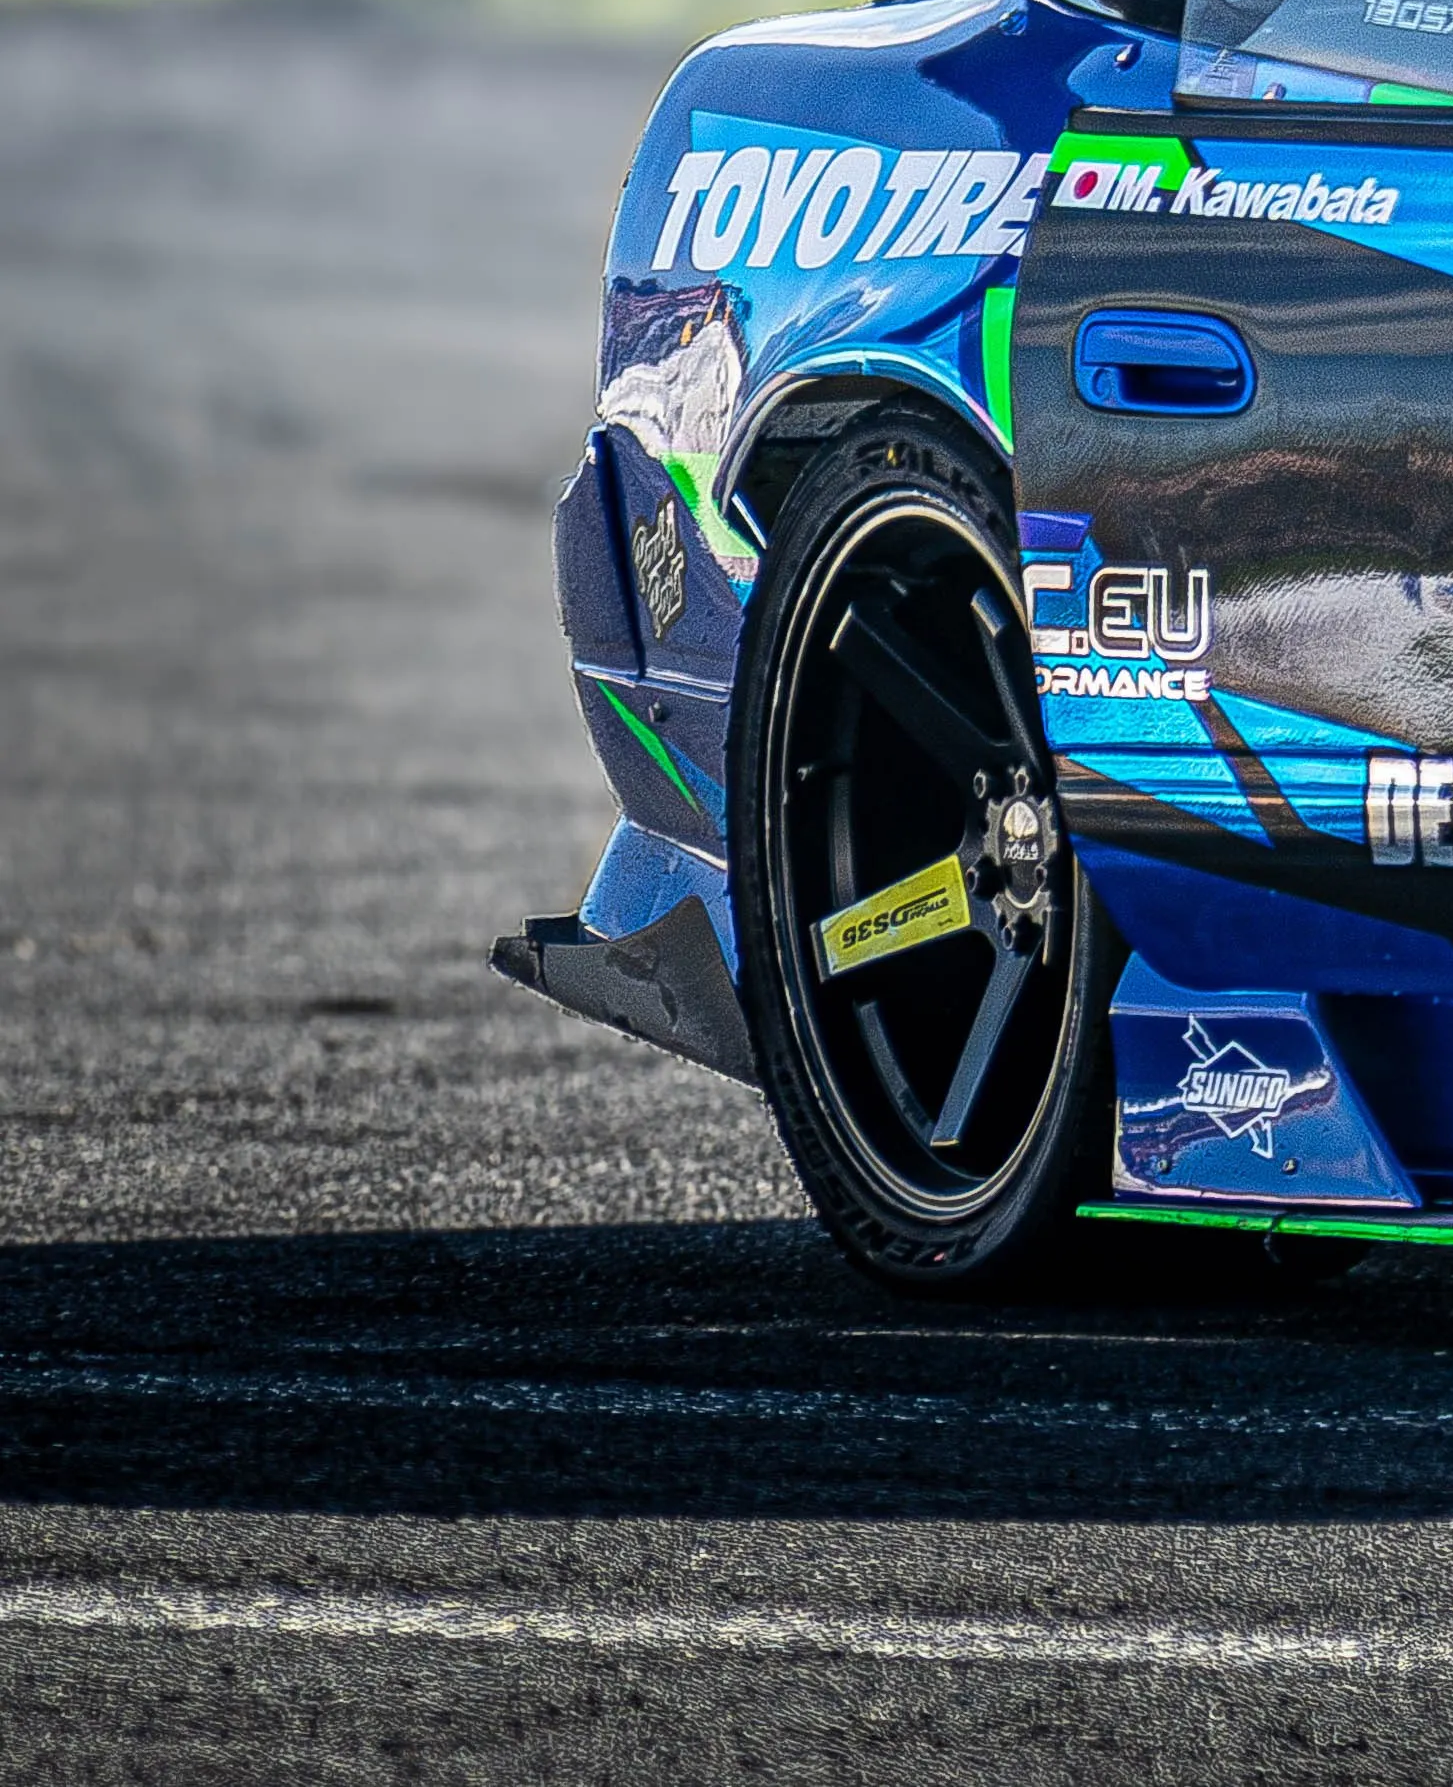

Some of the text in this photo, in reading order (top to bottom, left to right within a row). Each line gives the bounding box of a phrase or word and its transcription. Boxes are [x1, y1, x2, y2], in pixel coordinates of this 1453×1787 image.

[650, 146, 1051, 272] TOYO TIRE
[1117, 166, 1400, 226] M. Kawabata
[1184, 1069, 1286, 1110] SUNOCO
